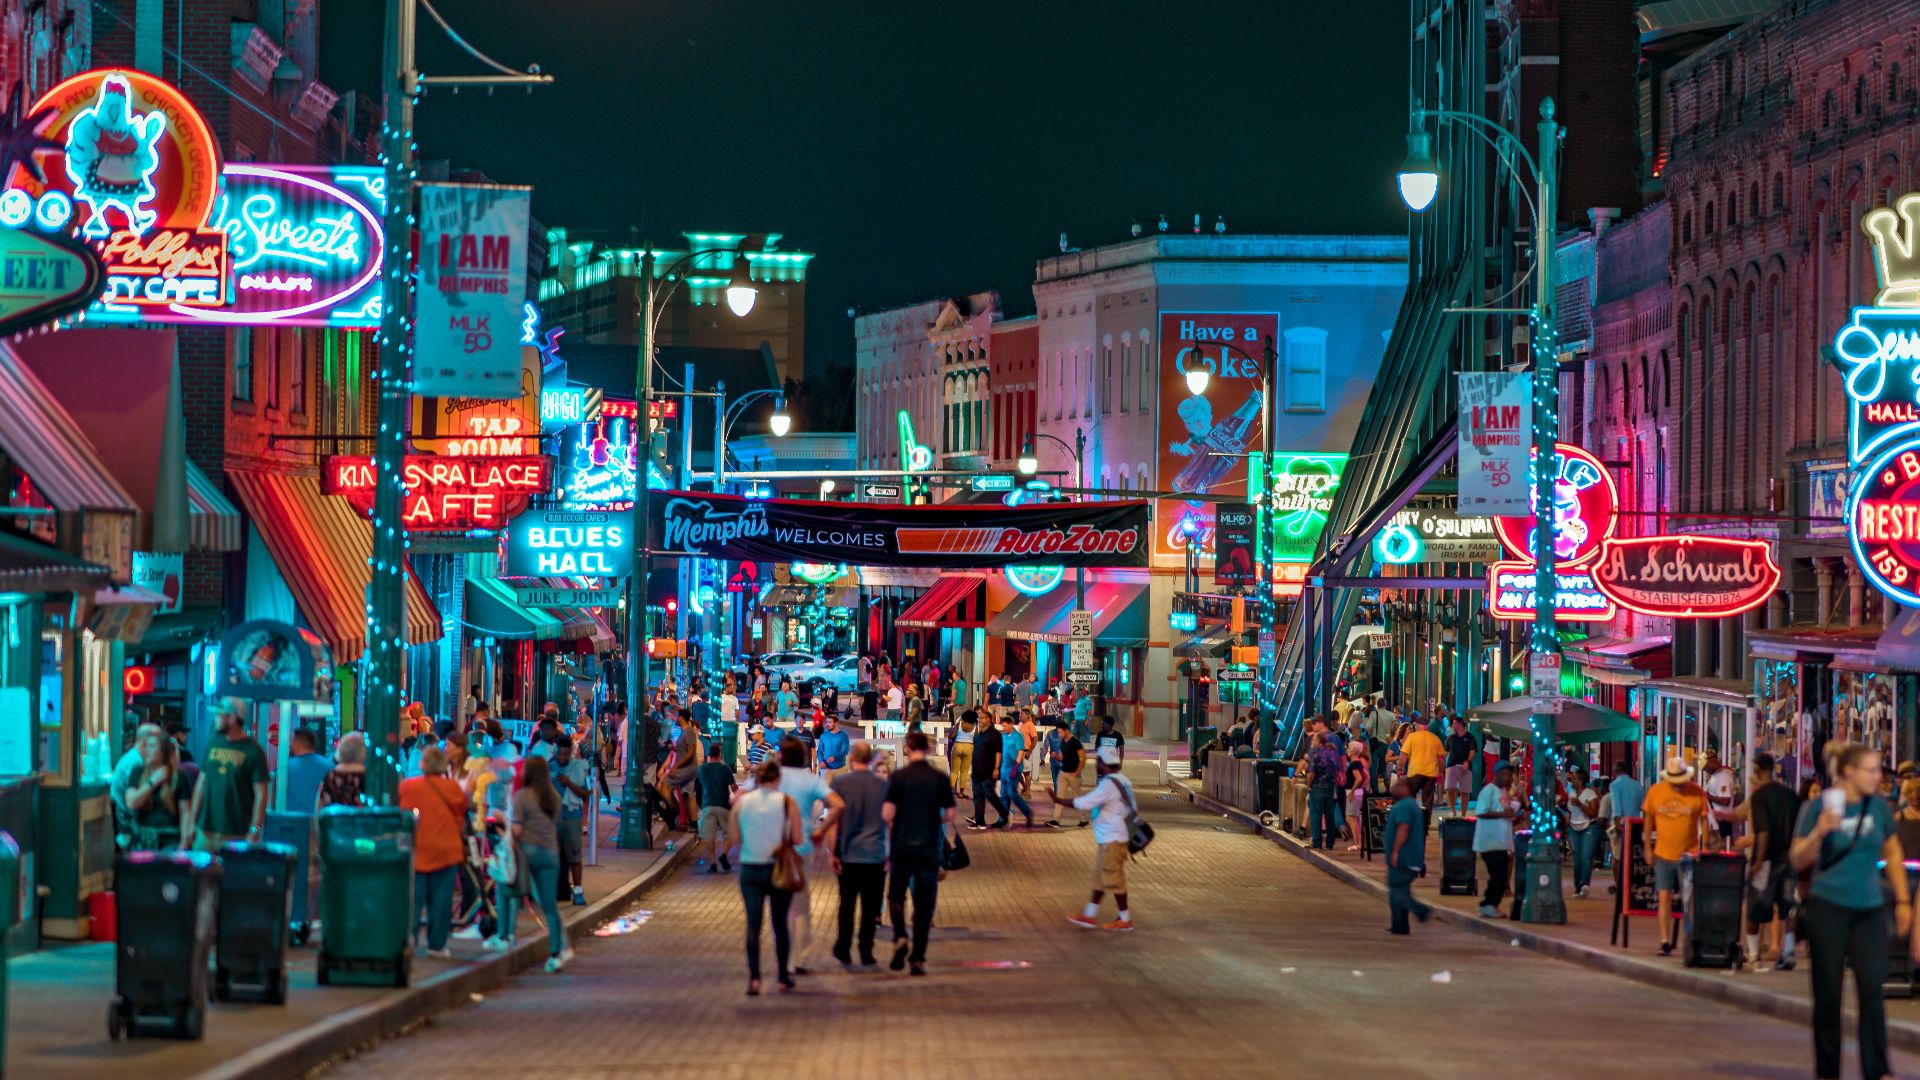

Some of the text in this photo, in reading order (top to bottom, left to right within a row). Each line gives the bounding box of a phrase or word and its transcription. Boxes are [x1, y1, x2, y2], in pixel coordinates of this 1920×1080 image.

[234, 194, 359, 269] Sweets
[440, 233, 510, 270] I AM
[438, 275, 509, 295] MEMPHIS
[449, 314, 490, 333] MLK
[1179, 319, 1258, 342] Have a
[463, 333, 493, 354] 50
[1175, 346, 1259, 379] Coke
[1472, 405, 1521, 430] I AM
[1866, 403, 1919, 421] HALL
[469, 417, 521, 436] TAP
[1472, 434, 1521, 447] MEMPHIS
[338, 465, 421, 488] KINS
[1480, 461, 1509, 473] MLK
[1491, 473, 1511, 488] 50
[404, 495, 494, 523] AFE
[548, 513, 560, 522] RUM
[562, 513, 584, 522] BOOGIE
[1194, 514, 1217, 522] DRIN
[528, 526, 622, 547] BLUES
[664, 514, 769, 553] Memphis
[775, 524, 1138, 554] WELCOMES AutoZone
[1424, 543, 1501, 551] WORLD FAMOU
[1440, 551, 1487, 559] IRISH BAR
[538, 552, 612, 573] HALL
[1601, 544, 1769, 583] A. Schwab
[1871, 548, 1909, 585] 159
[524, 591, 611, 604] JUKE JOINT
[1632, 592, 1742, 605] ESTABLISHED 1876
[1072, 625, 1091, 636] 25
